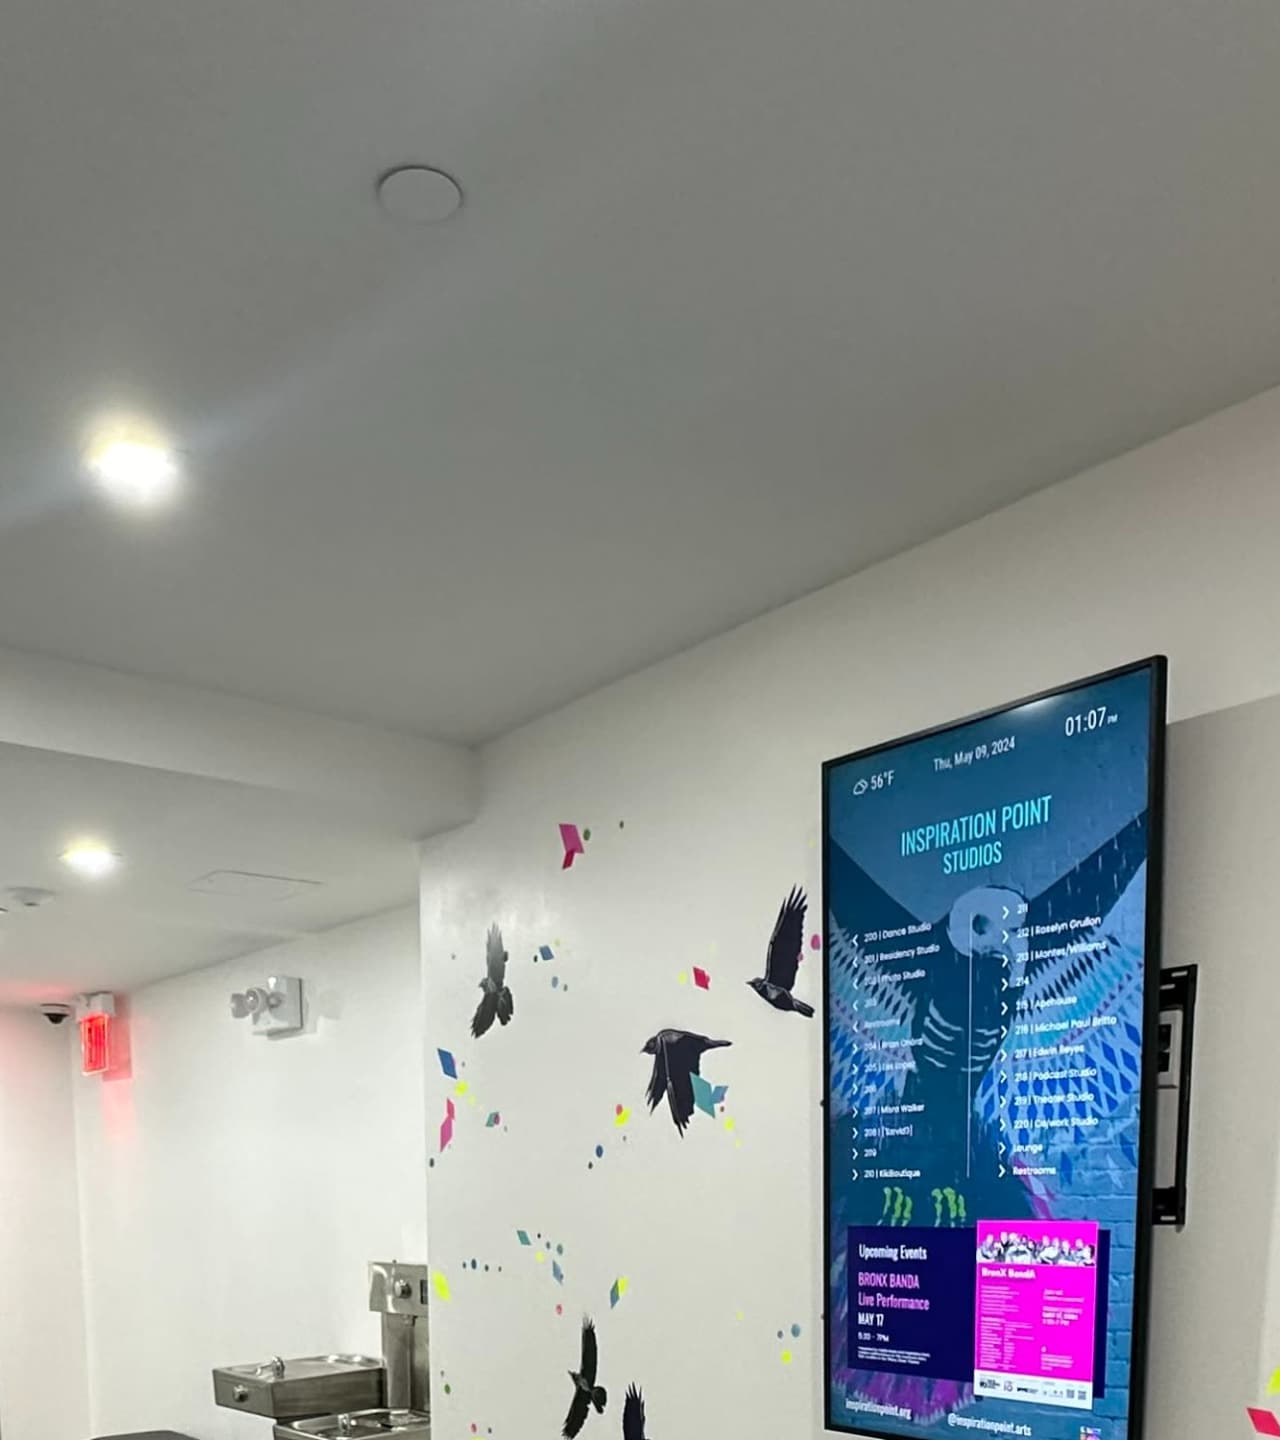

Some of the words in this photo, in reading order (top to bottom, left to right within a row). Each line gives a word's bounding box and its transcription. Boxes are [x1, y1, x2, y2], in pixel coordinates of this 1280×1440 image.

[1064, 706, 1107, 737] 01:07
[933, 758, 952, 772] Thu,
[954, 750, 973, 766] May
[975, 746, 990, 760] 09,
[991, 736, 1016, 755] 2024
[870, 769, 895, 791] 56°F
[901, 809, 996, 857] INSPIRATION
[1002, 794, 1052, 832] POINT
[943, 841, 1003, 874] STUDIOS
[882, 928, 906, 939] Dance
[908, 921, 932, 934] Studio
[916, 944, 940, 955] Studio
[903, 968, 926, 980] Studio
[1068, 1067, 1097, 1078] Studio
[1067, 1091, 1094, 1102] Studio
[1070, 1116, 1099, 1127] Studio
[1013, 1144, 1044, 1154] Lounge
[1013, 1166, 1056, 1176] Restrooms
[858, 1243, 899, 1262] Upcoming
[900, 1244, 927, 1260] Events
[858, 1272, 888, 1288] BRONX
[890, 1273, 920, 1289] BANDA
[858, 1292, 874, 1306] Live
[876, 1292, 930, 1310] Performance
[858, 1312, 874, 1326] MAY
[876, 1314, 884, 1327] 17
[846, 1398, 912, 1420] inspirationpoint.org
[948, 1413, 1032, 1436] @inspirationpoint.arts
